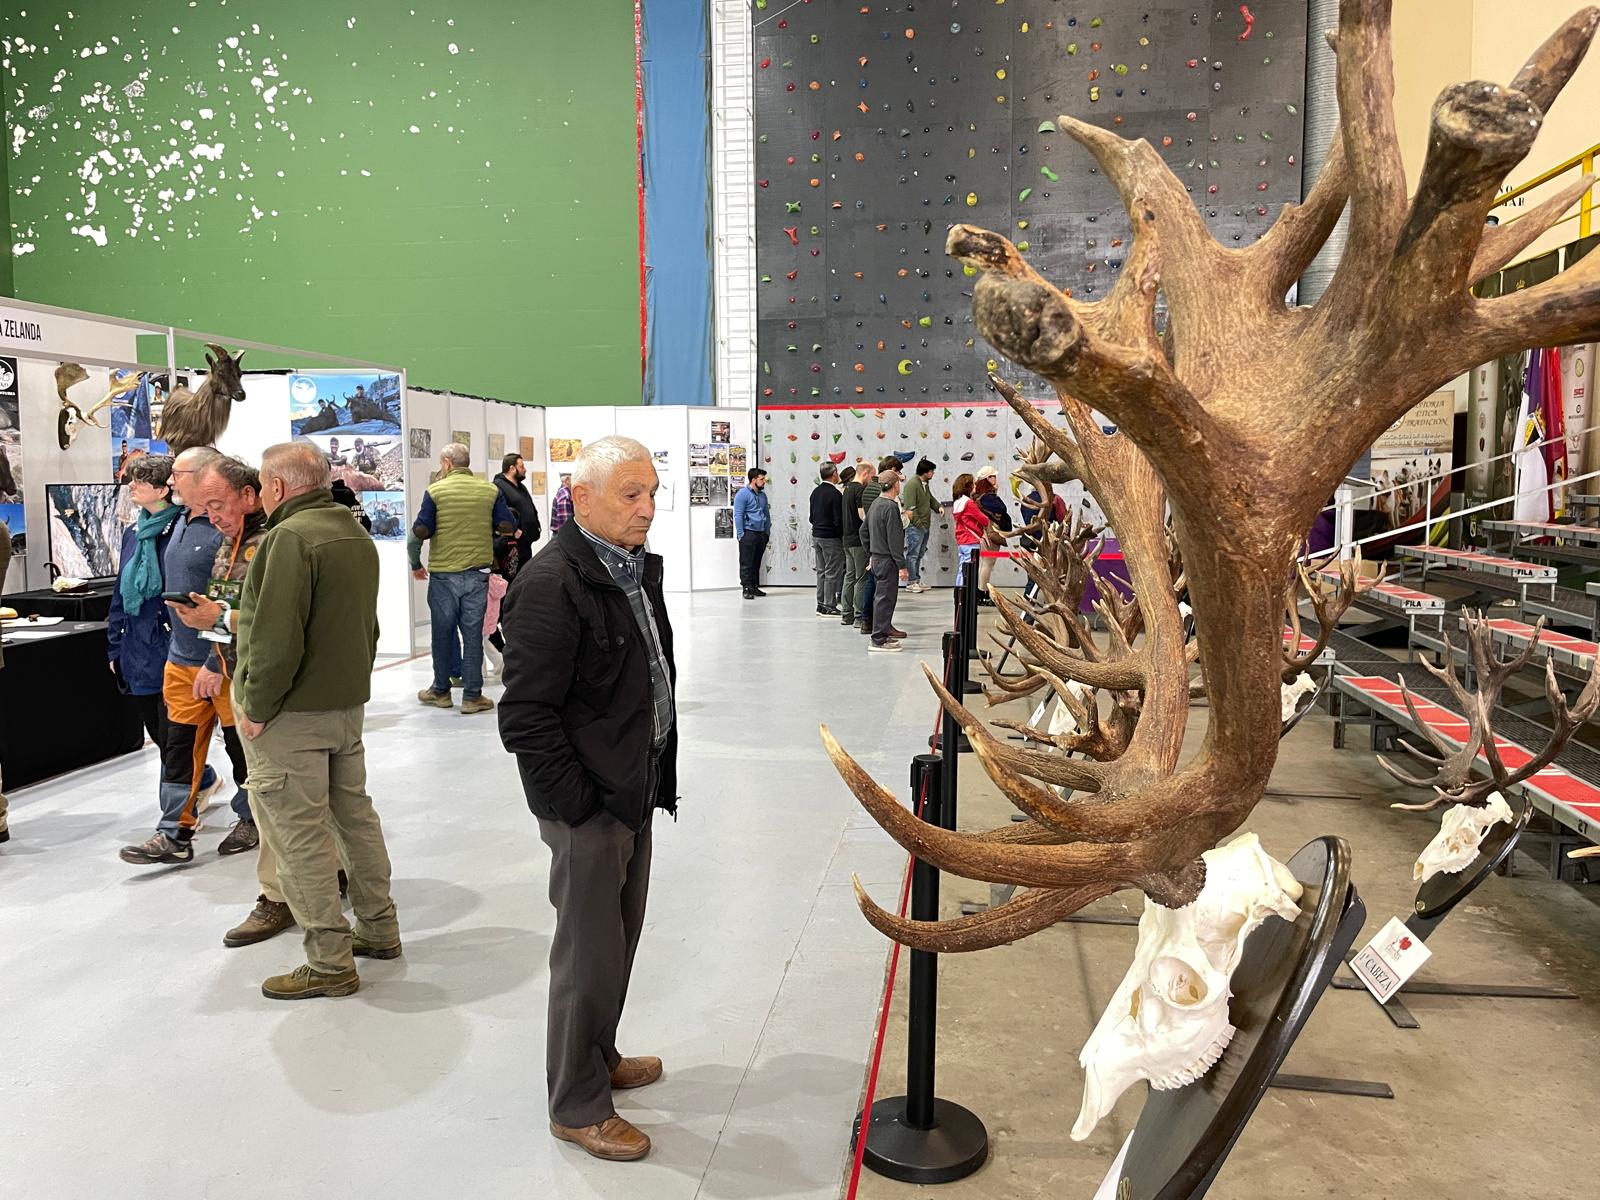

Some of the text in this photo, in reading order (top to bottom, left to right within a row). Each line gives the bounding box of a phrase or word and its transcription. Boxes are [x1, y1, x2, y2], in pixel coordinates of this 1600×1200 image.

[4, 319, 42, 341] ZELANDA
[1577, 818, 1588, 835] 27
[1364, 958, 1393, 991] CABEZA
